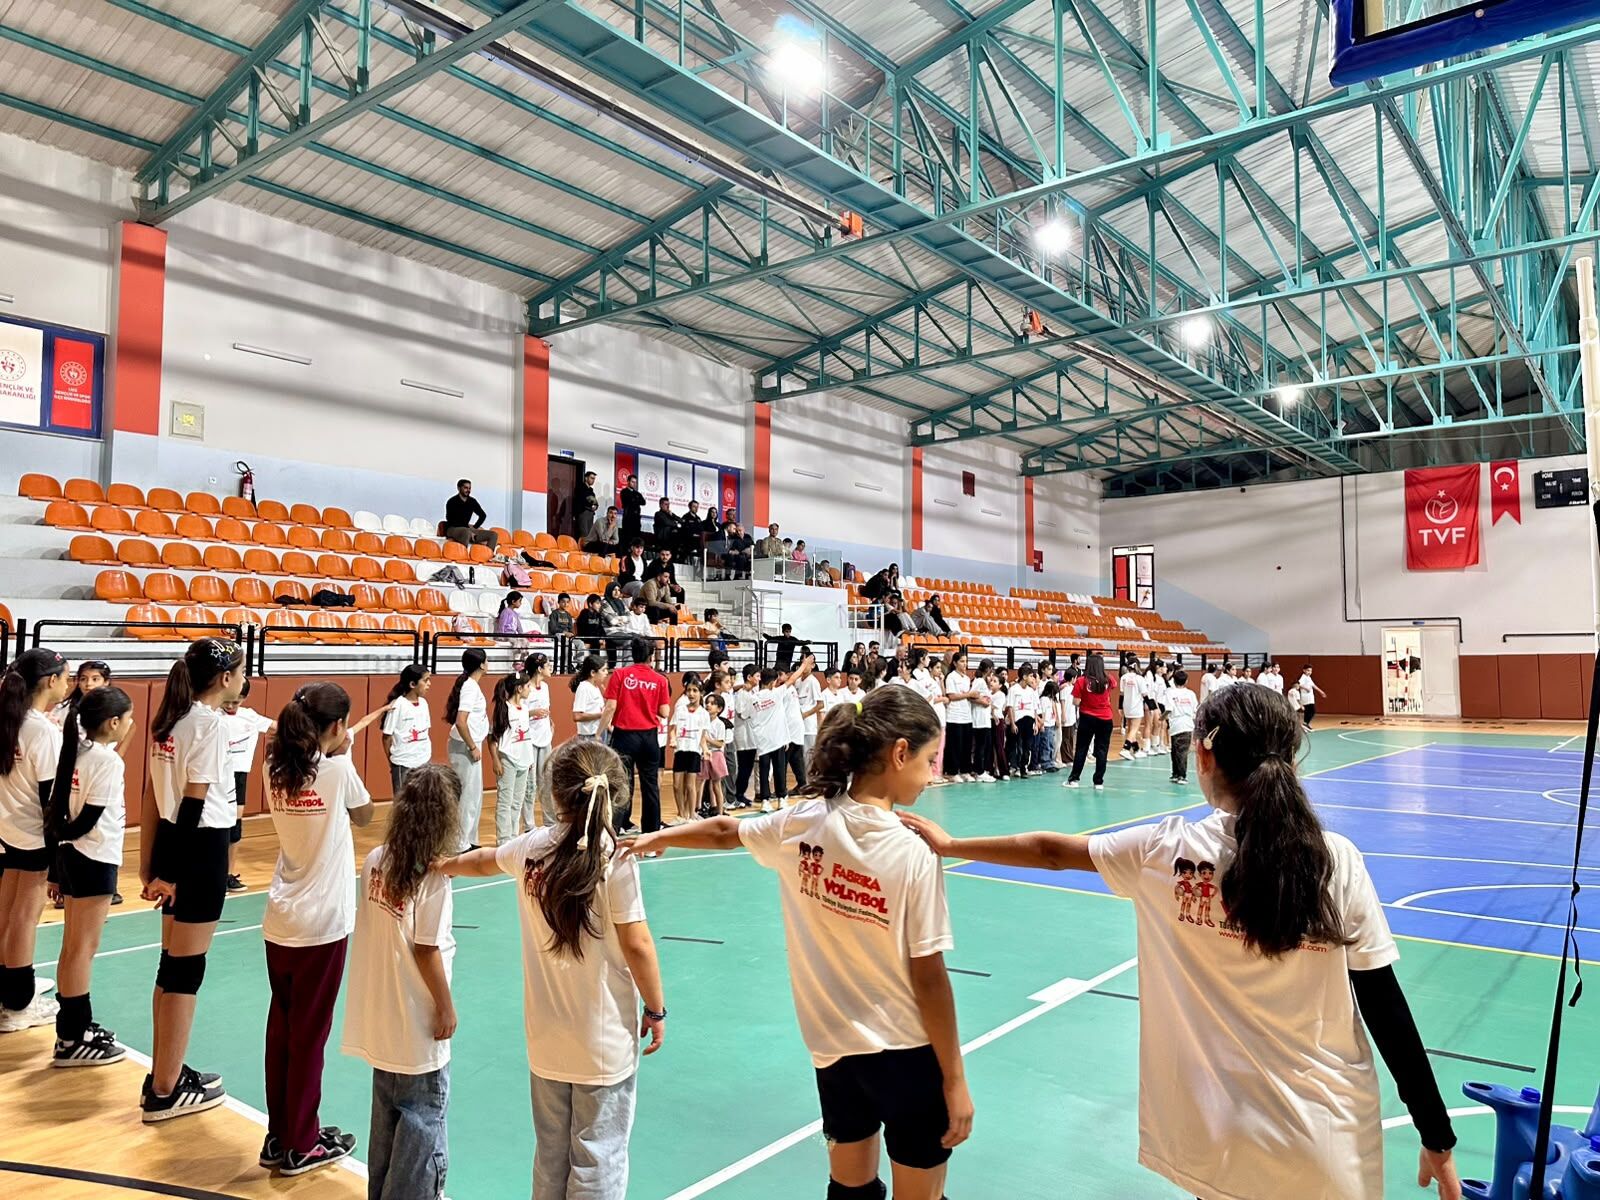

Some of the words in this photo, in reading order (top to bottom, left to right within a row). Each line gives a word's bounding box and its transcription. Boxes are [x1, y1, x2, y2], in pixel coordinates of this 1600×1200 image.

[1418, 527, 1466, 546] TVF
[639, 680, 657, 690] TVF
[823, 878, 888, 914] VOLEYBOL
